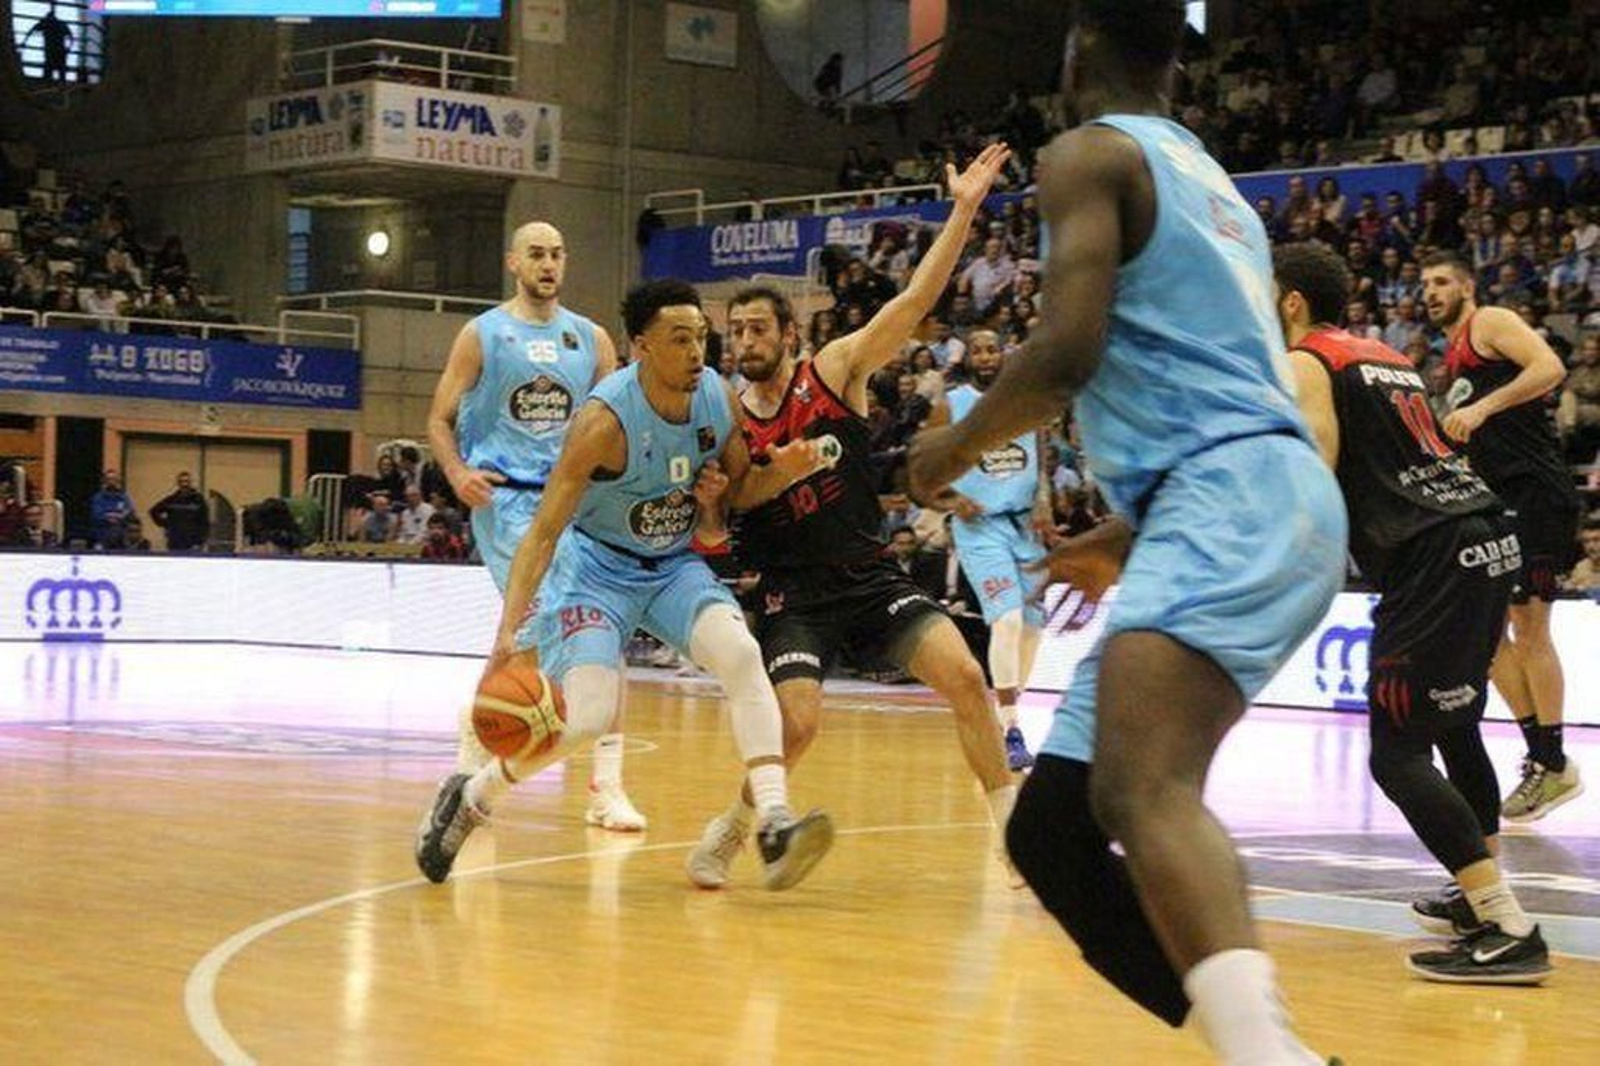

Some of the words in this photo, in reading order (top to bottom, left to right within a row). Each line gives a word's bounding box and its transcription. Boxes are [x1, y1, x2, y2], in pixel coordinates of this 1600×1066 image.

[269, 96, 325, 131] LEYMA
[416, 98, 497, 137] LEYMA
[415, 136, 525, 170] natura
[669, 455, 691, 483] 0
[640, 519, 690, 535] Galicia
